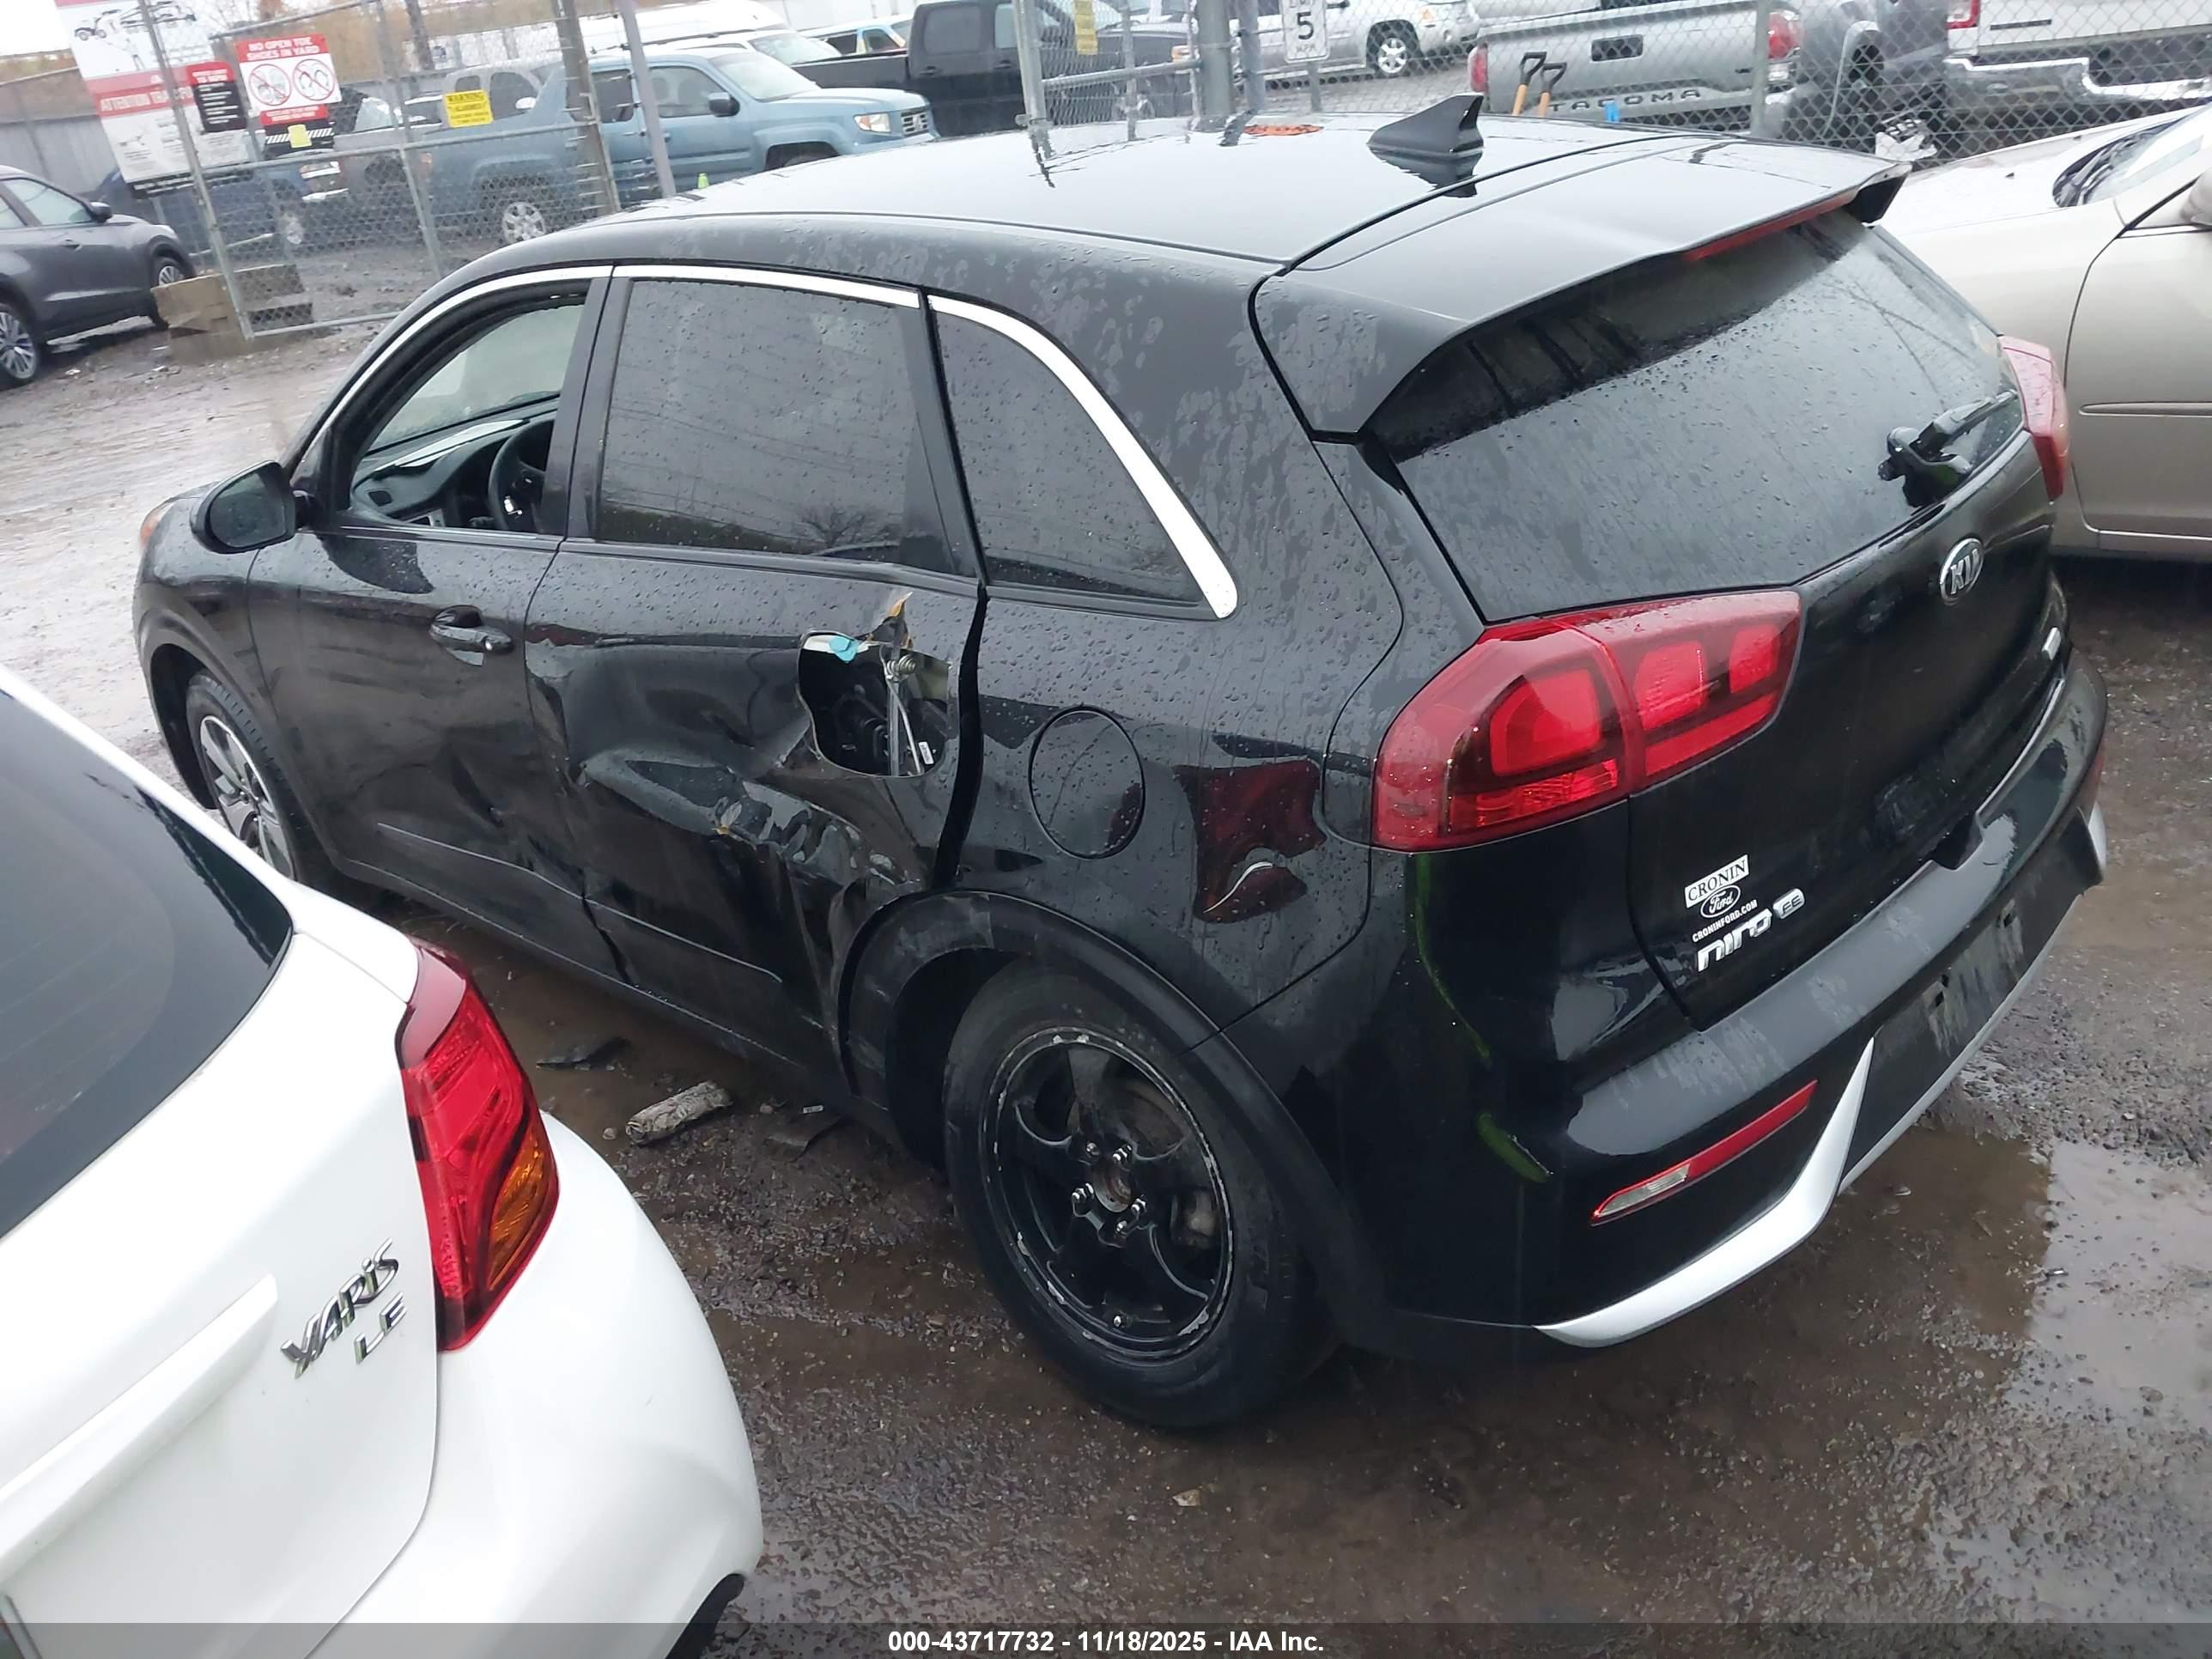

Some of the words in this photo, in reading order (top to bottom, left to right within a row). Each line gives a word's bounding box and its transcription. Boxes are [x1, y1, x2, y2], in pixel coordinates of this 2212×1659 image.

[1297, 11, 1314, 40] 5
[248, 42, 264, 52] NO
[264, 40, 292, 50] OPEN
[293, 45, 320, 56] YARD
[1549, 89, 1701, 112] TACOMA
[1950, 548, 1980, 594] KIA
[1688, 860, 1746, 902] CRONIN
[1709, 890, 1734, 914] Ford
[1692, 899, 1758, 943] CRONINFORD.COM
[354, 1291, 407, 1364] LE
